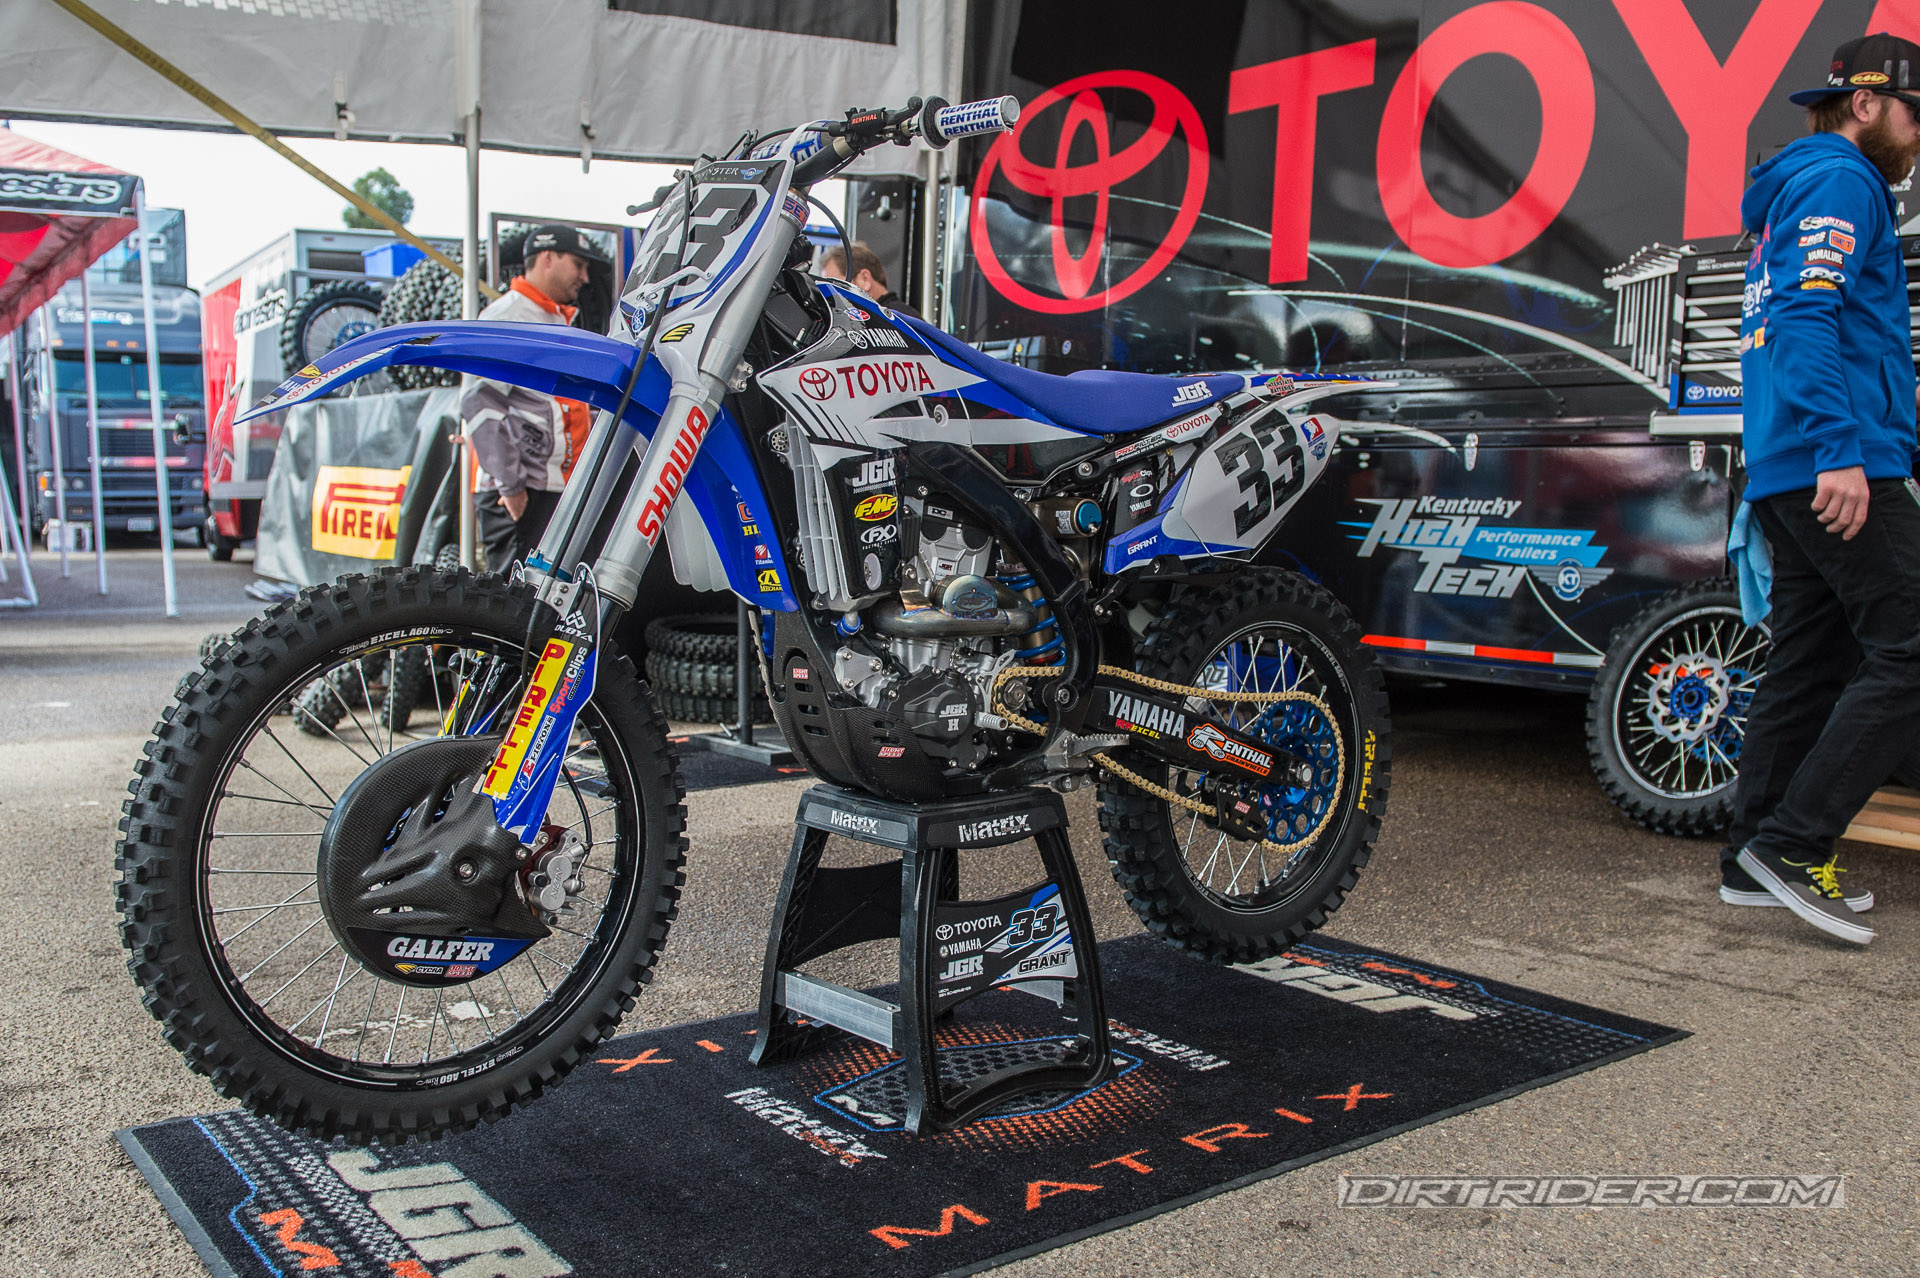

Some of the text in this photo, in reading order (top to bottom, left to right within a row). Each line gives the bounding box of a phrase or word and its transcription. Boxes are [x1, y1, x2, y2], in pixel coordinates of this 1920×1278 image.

[941, 98, 1000, 115] RENTHAL
[941, 107, 999, 127] RENTHAL
[851, 113, 878, 125] RENTHAL
[944, 118, 1003, 136] RENTHAL
[1229, 0, 1920, 285] TOY
[1832, 236, 1852, 248] GET
[1808, 249, 1843, 265] YAMALUBE
[860, 328, 909, 348] YAMAHA
[304, 359, 360, 390] TOYOTA
[836, 361, 935, 399] TOYOTA
[1266, 379, 1293, 389] INTERSTATE
[1173, 381, 1211, 402] JGR
[1176, 414, 1212, 435] TOYOTA
[637, 405, 709, 548] SHOWA
[852, 457, 896, 488] JGR
[1214, 407, 1305, 540] 33
[855, 495, 898, 518] FMF
[1416, 496, 1522, 519] Kentucky
[1354, 499, 1481, 558] HIGH
[1476, 529, 1582, 547] Performance
[1127, 534, 1158, 555] GRANT
[1495, 545, 1557, 561] Trailers
[370, 629, 408, 646] EXCEL
[408, 627, 430, 637] A60
[554, 624, 593, 643] DUBYA
[549, 646, 588, 714] SportClips
[484, 643, 566, 789] PIRELLI
[939, 704, 968, 715] JGR
[1108, 690, 1186, 740] YAMAHA
[530, 716, 556, 763] PISTONS
[1131, 725, 1161, 740] EXCEL
[1225, 755, 1269, 775] CHAINWHEELS
[830, 809, 880, 835] Matrix
[958, 813, 1032, 844] Matrix
[954, 915, 1002, 932] TOYOTA
[1007, 903, 1060, 948] 33
[387, 937, 495, 962] GALFER
[948, 938, 982, 954] YAMAHA
[415, 966, 443, 975] CYCRA
[939, 954, 985, 981] JGR
[1018, 950, 1070, 975] GRANT
[461, 1056, 496, 1078] EXCEL
[869, 1083, 1395, 1250] MATRIX
